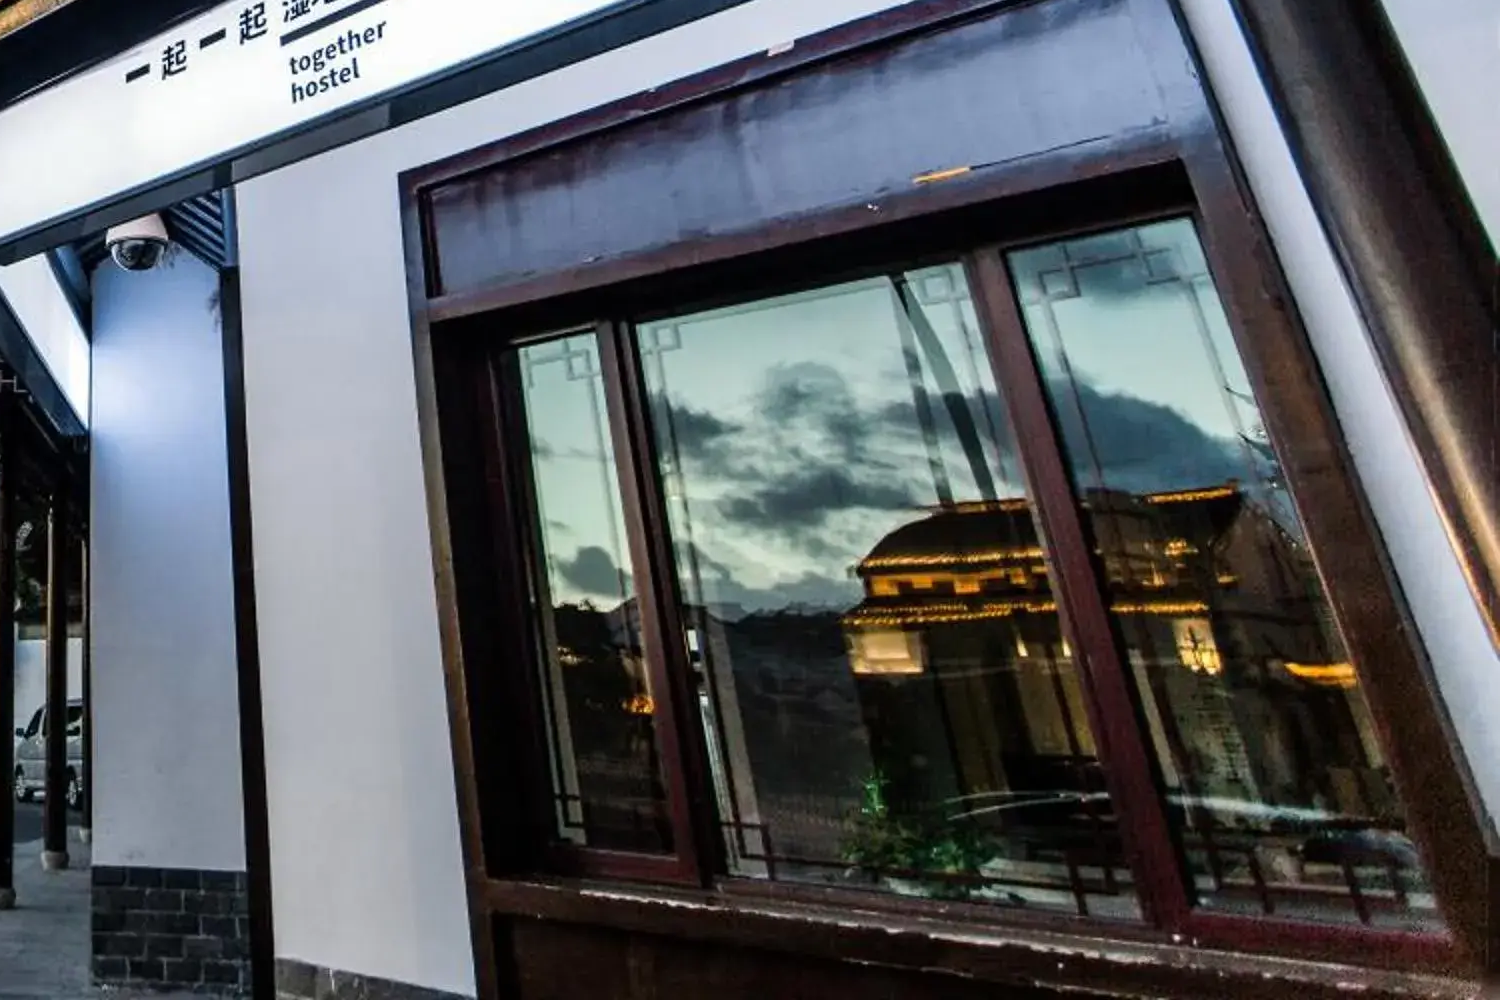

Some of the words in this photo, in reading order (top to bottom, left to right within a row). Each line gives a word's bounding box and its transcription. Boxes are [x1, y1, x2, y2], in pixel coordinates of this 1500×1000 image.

[125, 3, 268, 84] 一起一起
[288, 21, 387, 75] together
[291, 57, 360, 104] hostel
